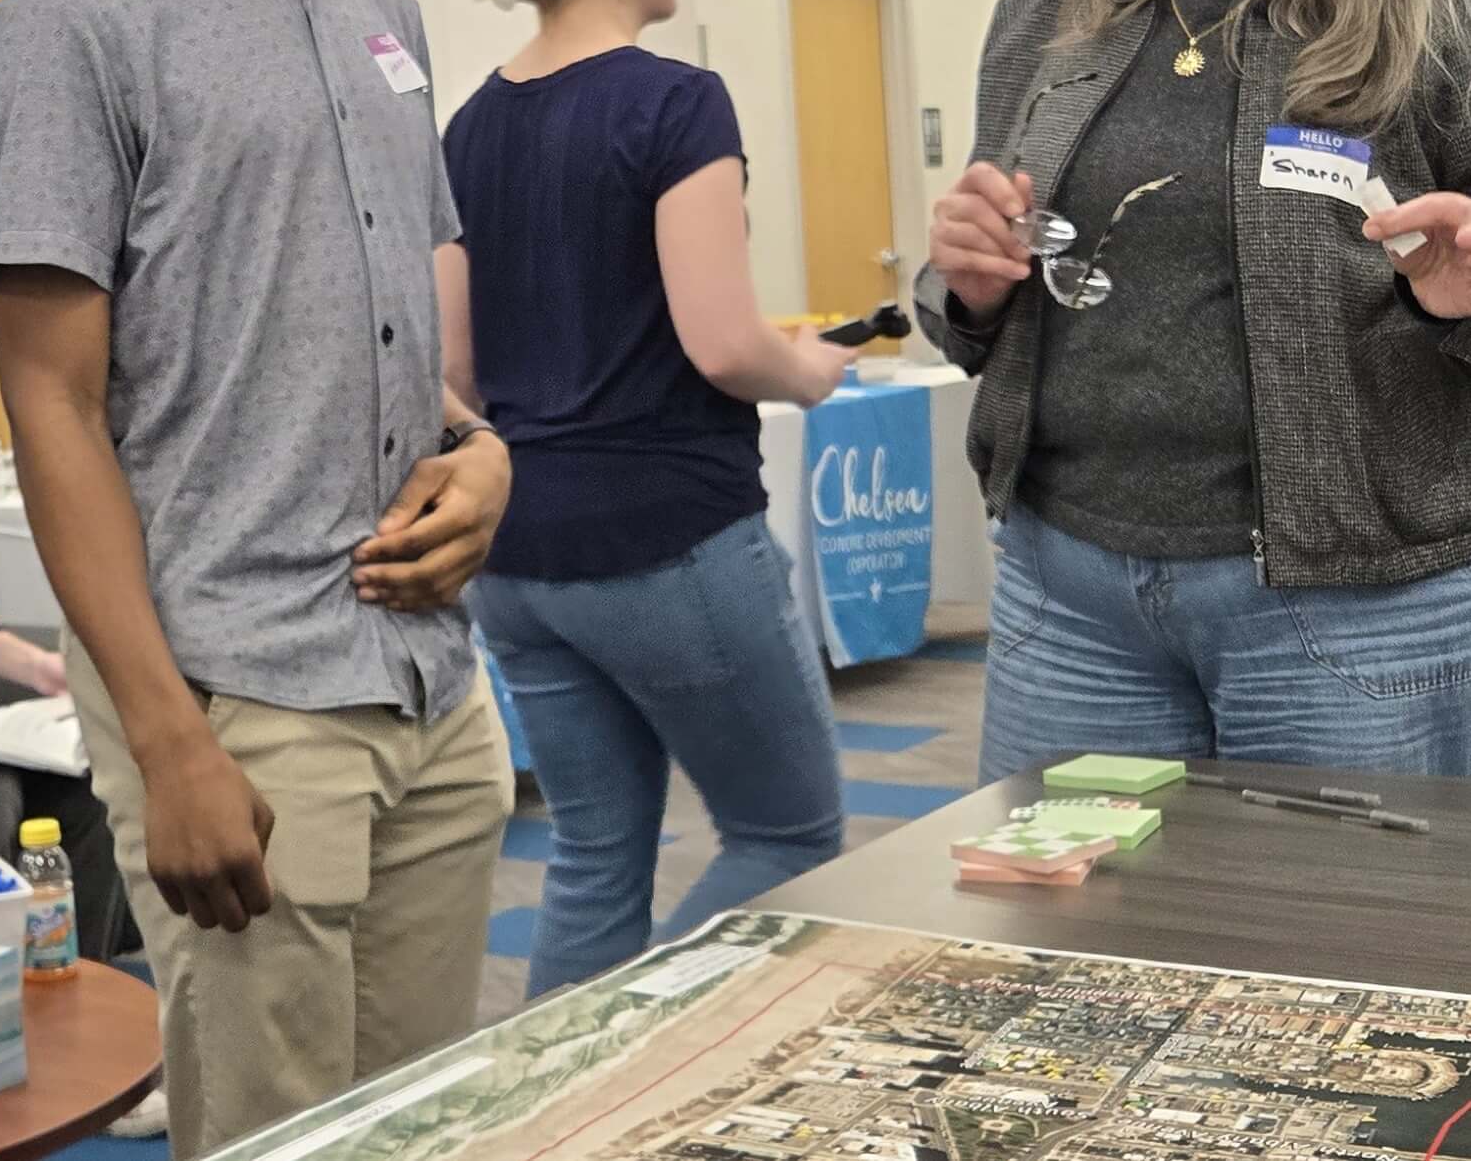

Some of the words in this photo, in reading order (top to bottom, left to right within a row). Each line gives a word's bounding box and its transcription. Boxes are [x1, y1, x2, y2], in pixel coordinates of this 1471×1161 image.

[1299, 129, 1344, 148] HELLO
[811, 444, 929, 527] Chelsea
[924, 1096, 1010, 1112] Albany
[1017, 1106, 1093, 1120] South
[1216, 1134, 1311, 1151] Albany
[1318, 1146, 1399, 1161] North
